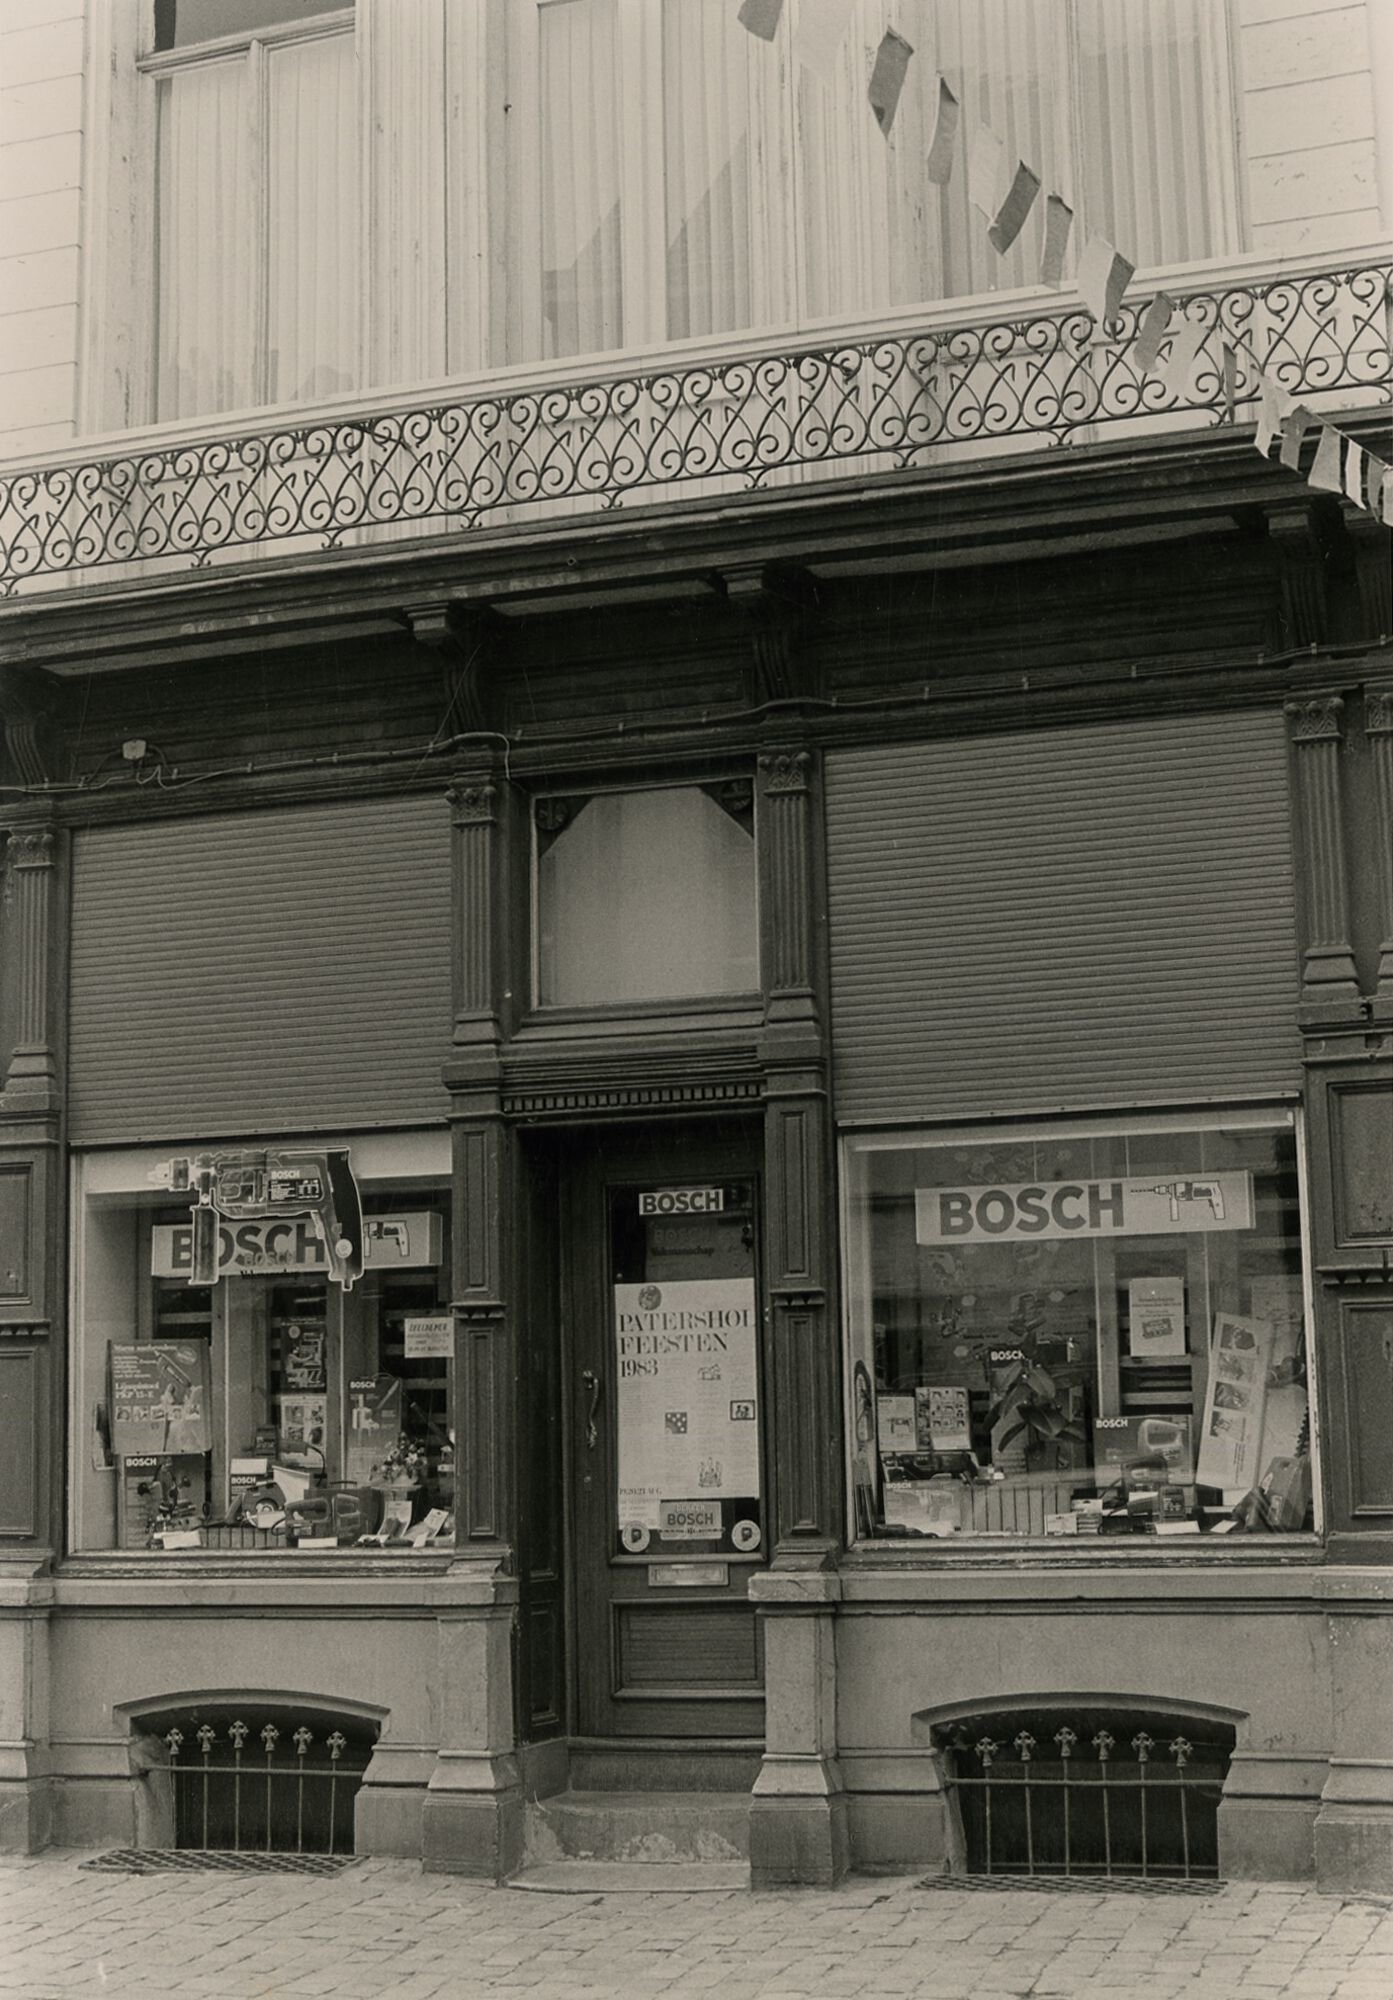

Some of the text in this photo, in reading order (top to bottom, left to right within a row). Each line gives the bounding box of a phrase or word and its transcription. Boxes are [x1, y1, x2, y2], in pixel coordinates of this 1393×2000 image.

[271, 1169, 300, 1179] BOSCH
[642, 1190, 721, 1214] BOSCH
[939, 1182, 1125, 1236] BOSCH
[620, 1333, 729, 1354] FEESTEN
[620, 1358, 658, 1378] 1983
[349, 1380, 377, 1390] BOSCH
[1095, 1418, 1129, 1430] BOSCH
[125, 1458, 157, 1468] BOSCH
[231, 1476, 257, 1485] BOSCH
[885, 1482, 913, 1491] BOSCH
[667, 1512, 714, 1526] BOSCH
